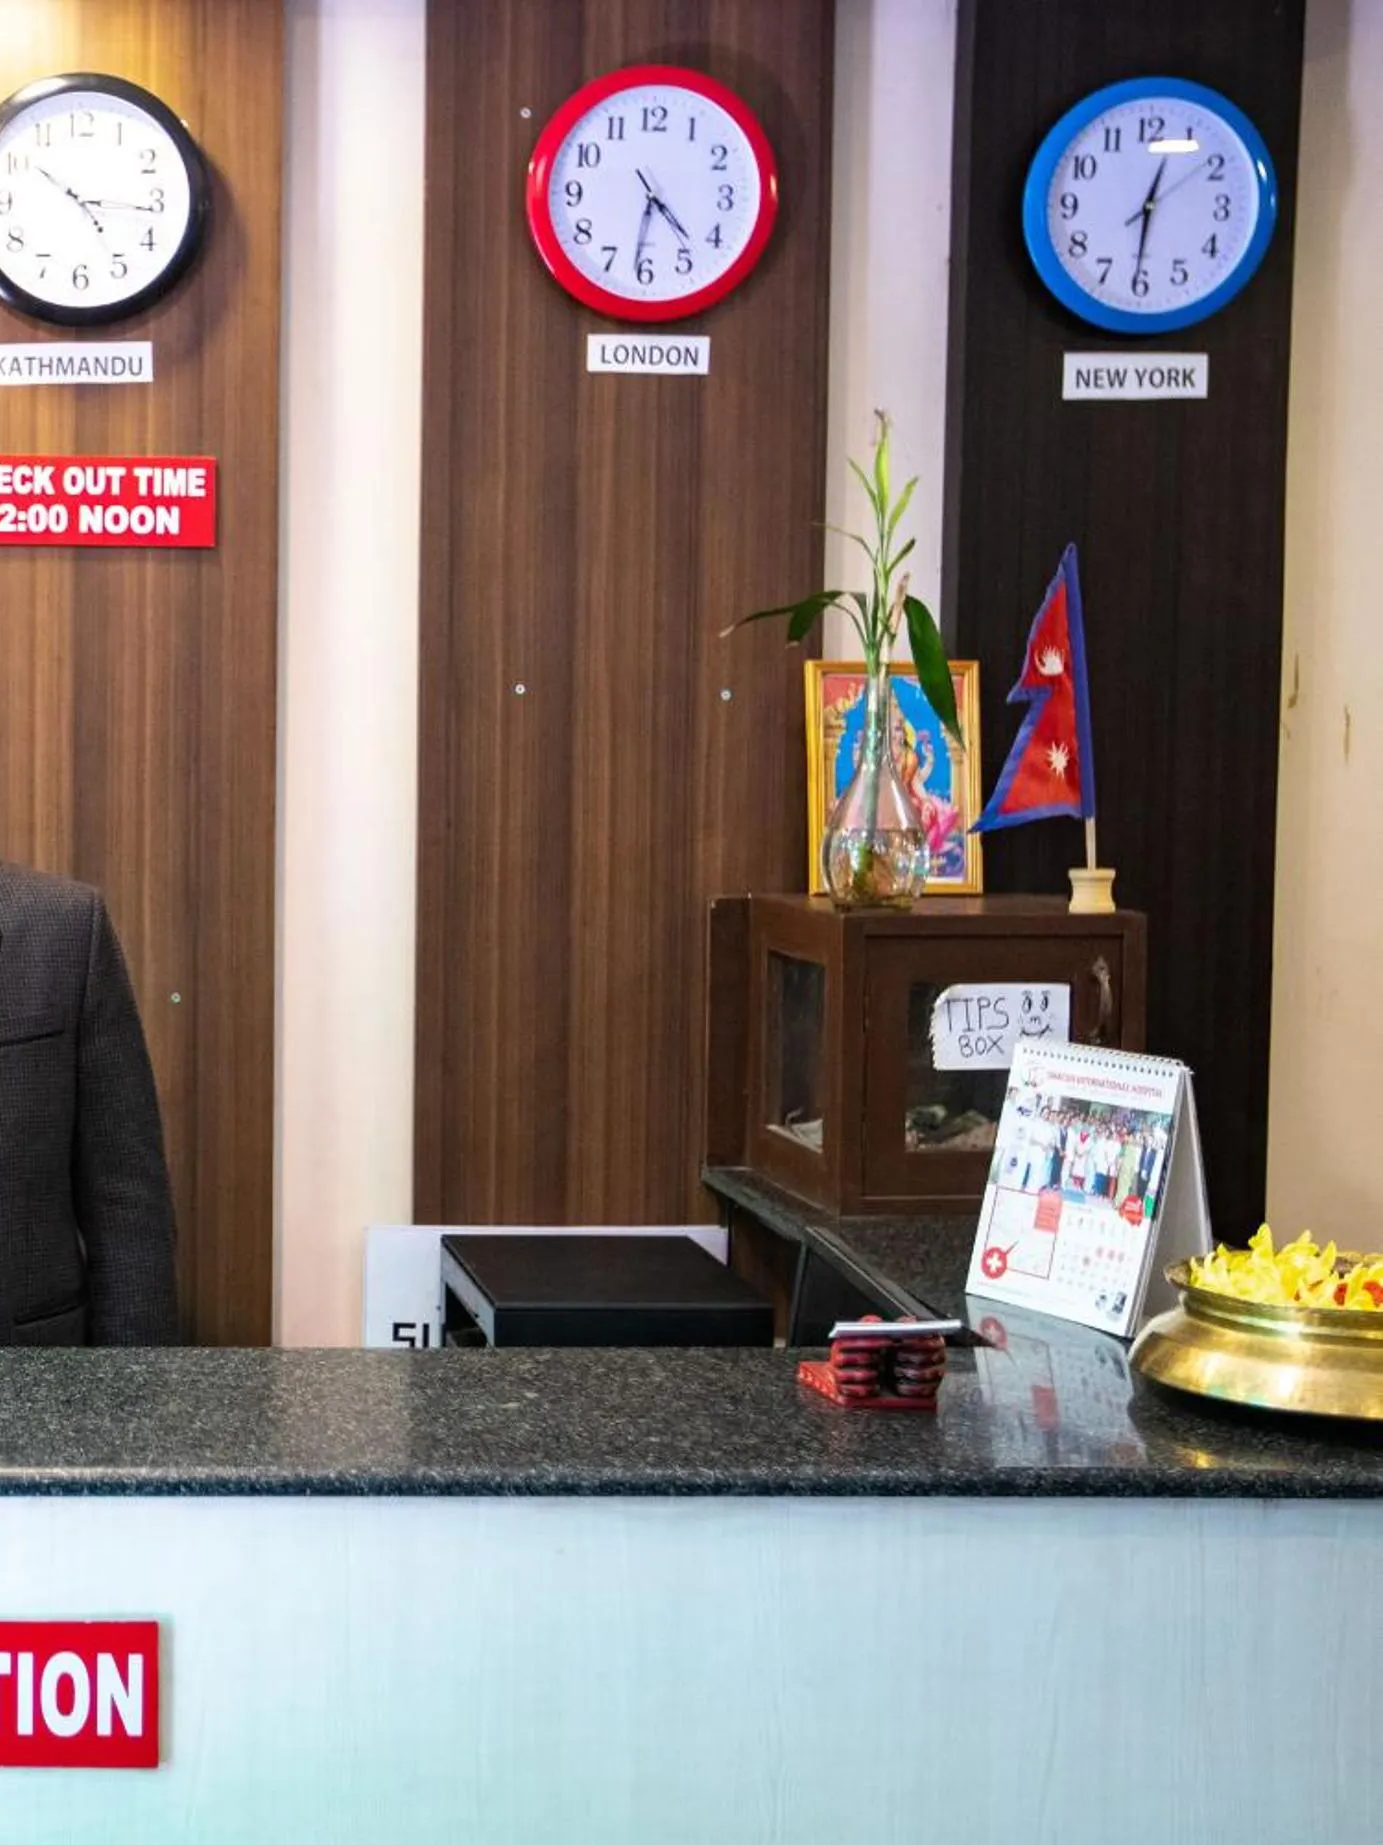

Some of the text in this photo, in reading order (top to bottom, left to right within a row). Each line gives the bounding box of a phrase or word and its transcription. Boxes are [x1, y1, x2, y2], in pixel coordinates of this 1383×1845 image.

[69, 112, 95, 138] 12
[607, 116, 624, 141] 11
[641, 106, 668, 132] 12
[688, 117, 696, 141] 1
[1137, 117, 1165, 143] 12
[35, 122, 51, 147] 11
[1102, 127, 1121, 152] 11
[140, 148, 157, 174] 2
[577, 143, 601, 168] 10
[711, 144, 727, 171] 2
[1072, 154, 1097, 180] 10
[1207, 155, 1225, 181] 2
[149, 188, 164, 214] 3
[565, 180, 583, 207] 9
[717, 184, 734, 211] 3
[1060, 194, 1078, 220] 9
[1213, 195, 1231, 222] 3
[6, 227, 25, 252] 8
[139, 227, 156, 252] 4
[573, 218, 593, 244] 8
[705, 224, 722, 249] 4
[1068, 231, 1088, 258] 8
[1201, 233, 1217, 259] 4
[110, 253, 128, 279] 5
[601, 246, 618, 272] 7
[637, 259, 654, 285] 6
[675, 249, 693, 274] 5
[72, 264, 89, 290] 6
[1096, 259, 1113, 286] 7
[1132, 270, 1149, 297] 6
[1170, 260, 1188, 286] 5
[600, 344, 699, 367] LONDON
[1075, 367, 1196, 389] NEW YORK
[63, 466, 127, 495] OUT
[133, 468, 206, 497] TIME
[78, 505, 180, 534] NOON
[942, 996, 1009, 1033] TIPS
[958, 1034, 1005, 1058] BOX
